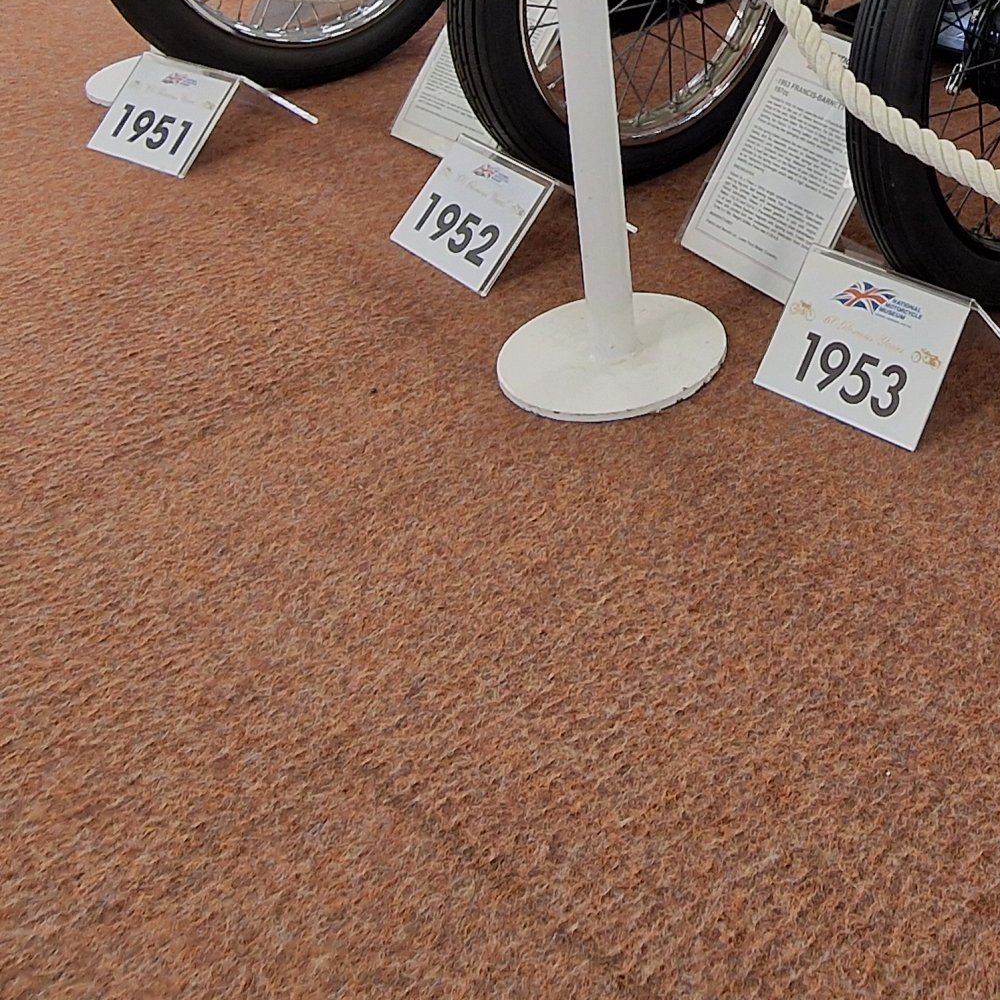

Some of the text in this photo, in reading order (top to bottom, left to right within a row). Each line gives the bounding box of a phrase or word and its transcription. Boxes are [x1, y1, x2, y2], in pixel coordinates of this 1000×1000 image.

[111, 103, 193, 155] 1951
[415, 192, 500, 268] 1952
[879, 307, 906, 321] MUSEUM
[885, 303, 923, 320] MOTORCYCLE
[892, 299, 921, 313] NATIONAL
[795, 331, 908, 418] 1953
